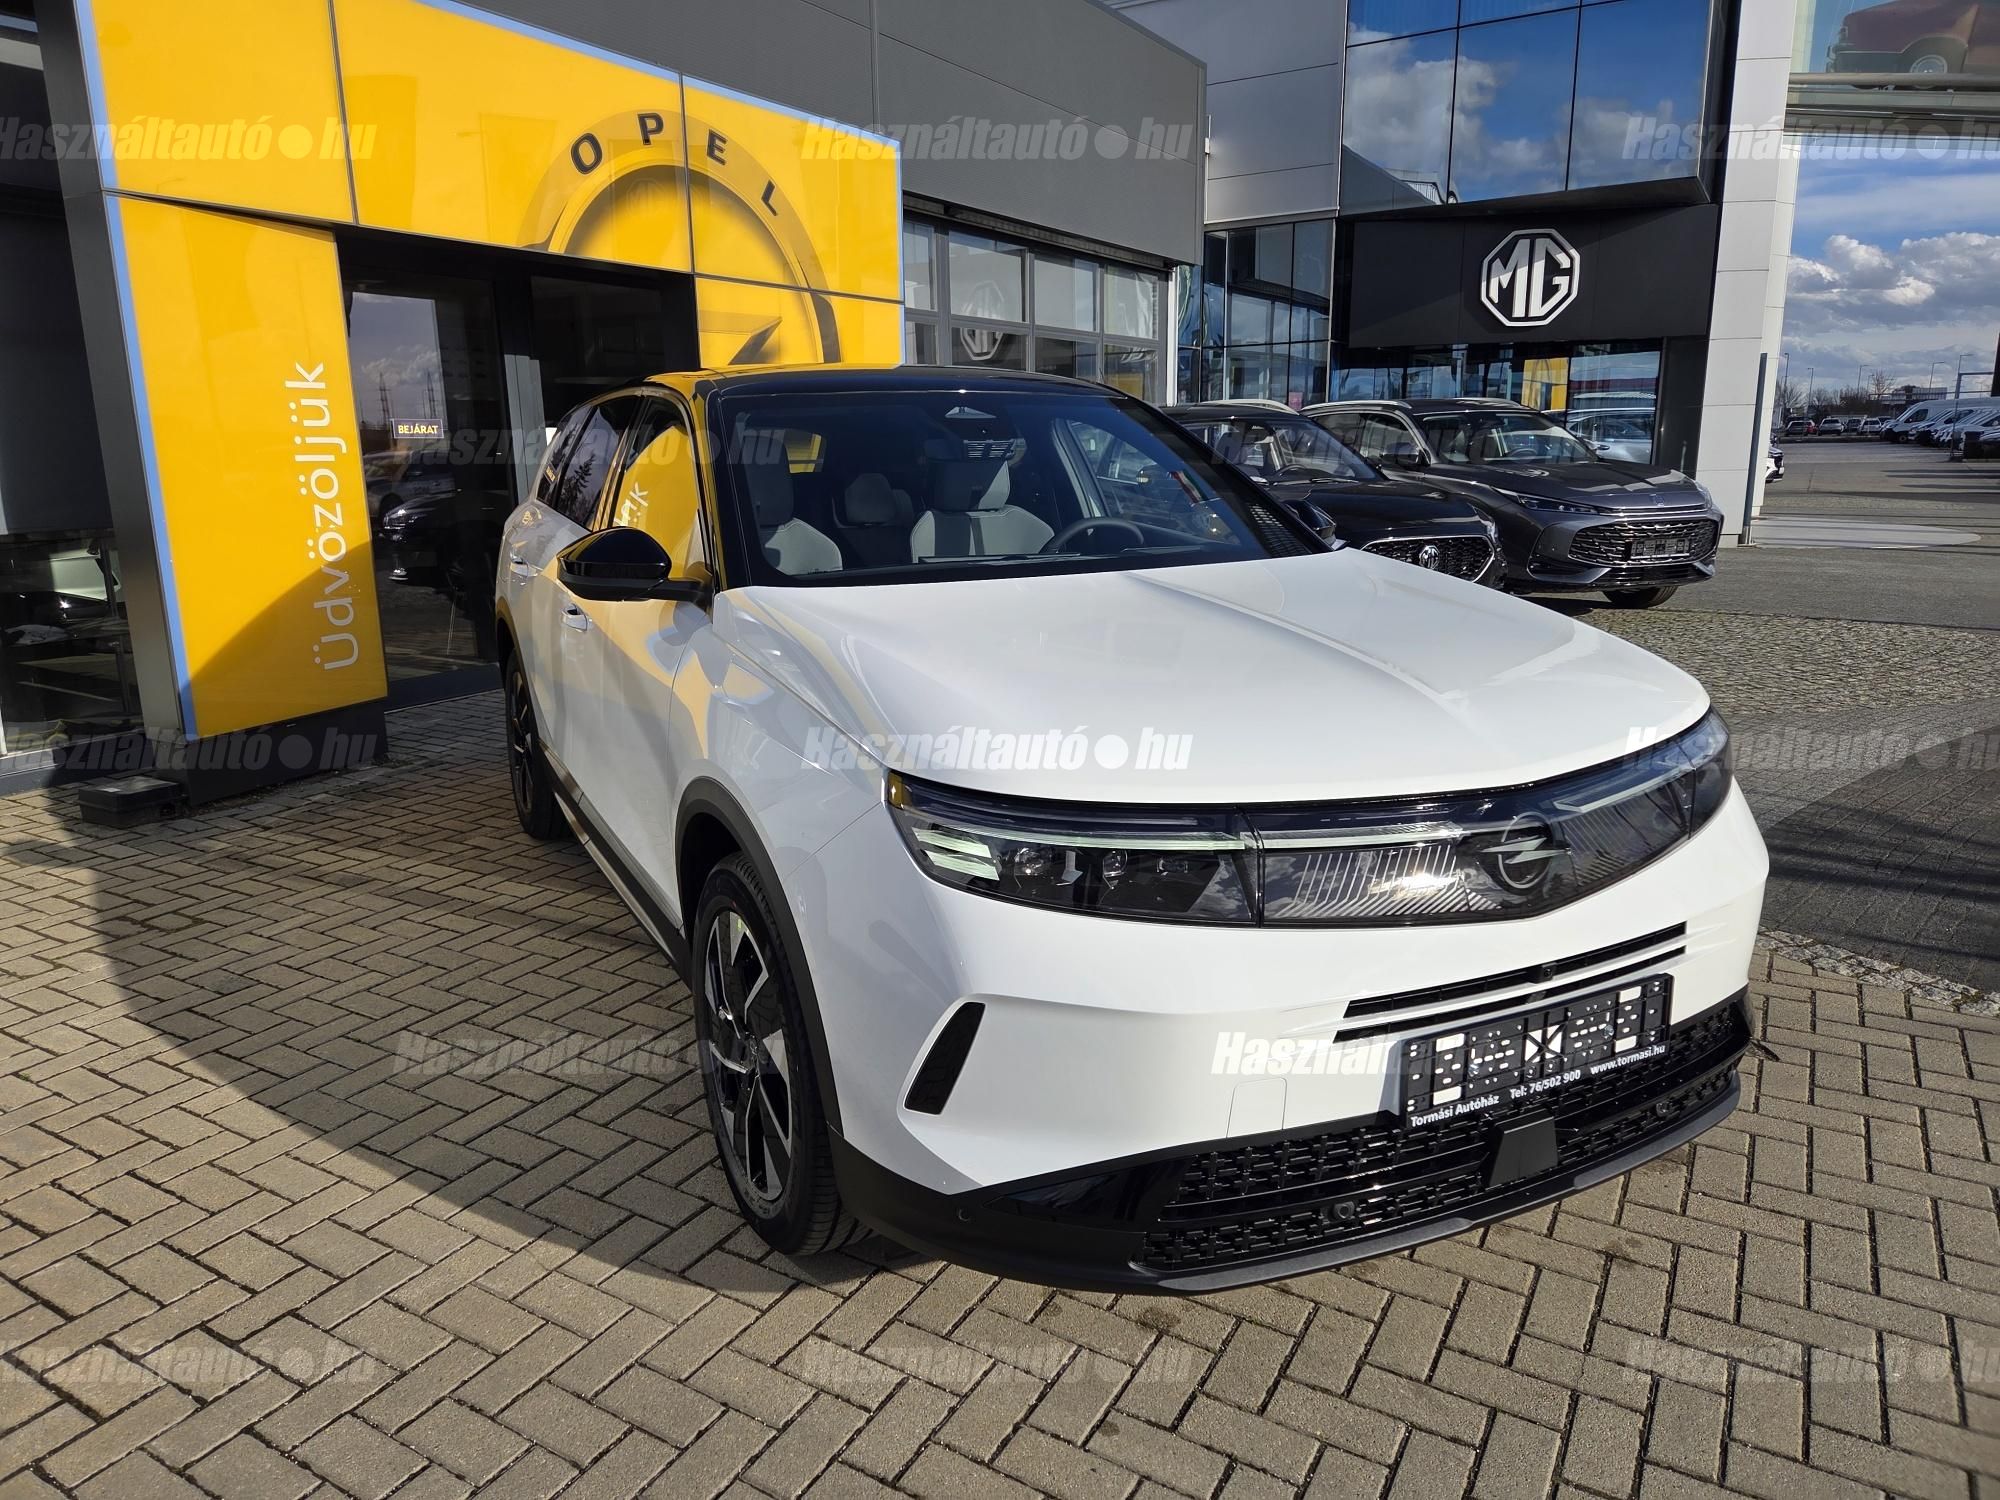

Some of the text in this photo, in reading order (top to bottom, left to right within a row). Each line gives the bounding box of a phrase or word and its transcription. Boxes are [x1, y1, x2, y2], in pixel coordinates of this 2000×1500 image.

[571, 112, 779, 217] OPEL
[1488, 238, 1571, 318] MG
[397, 422, 439, 435] BEJÁRAT
[285, 361, 360, 671] Üdvözöljük
[1410, 1044, 1666, 1127] Tormási Autóház Tel: 76/502 900 www.tormasi.hu
